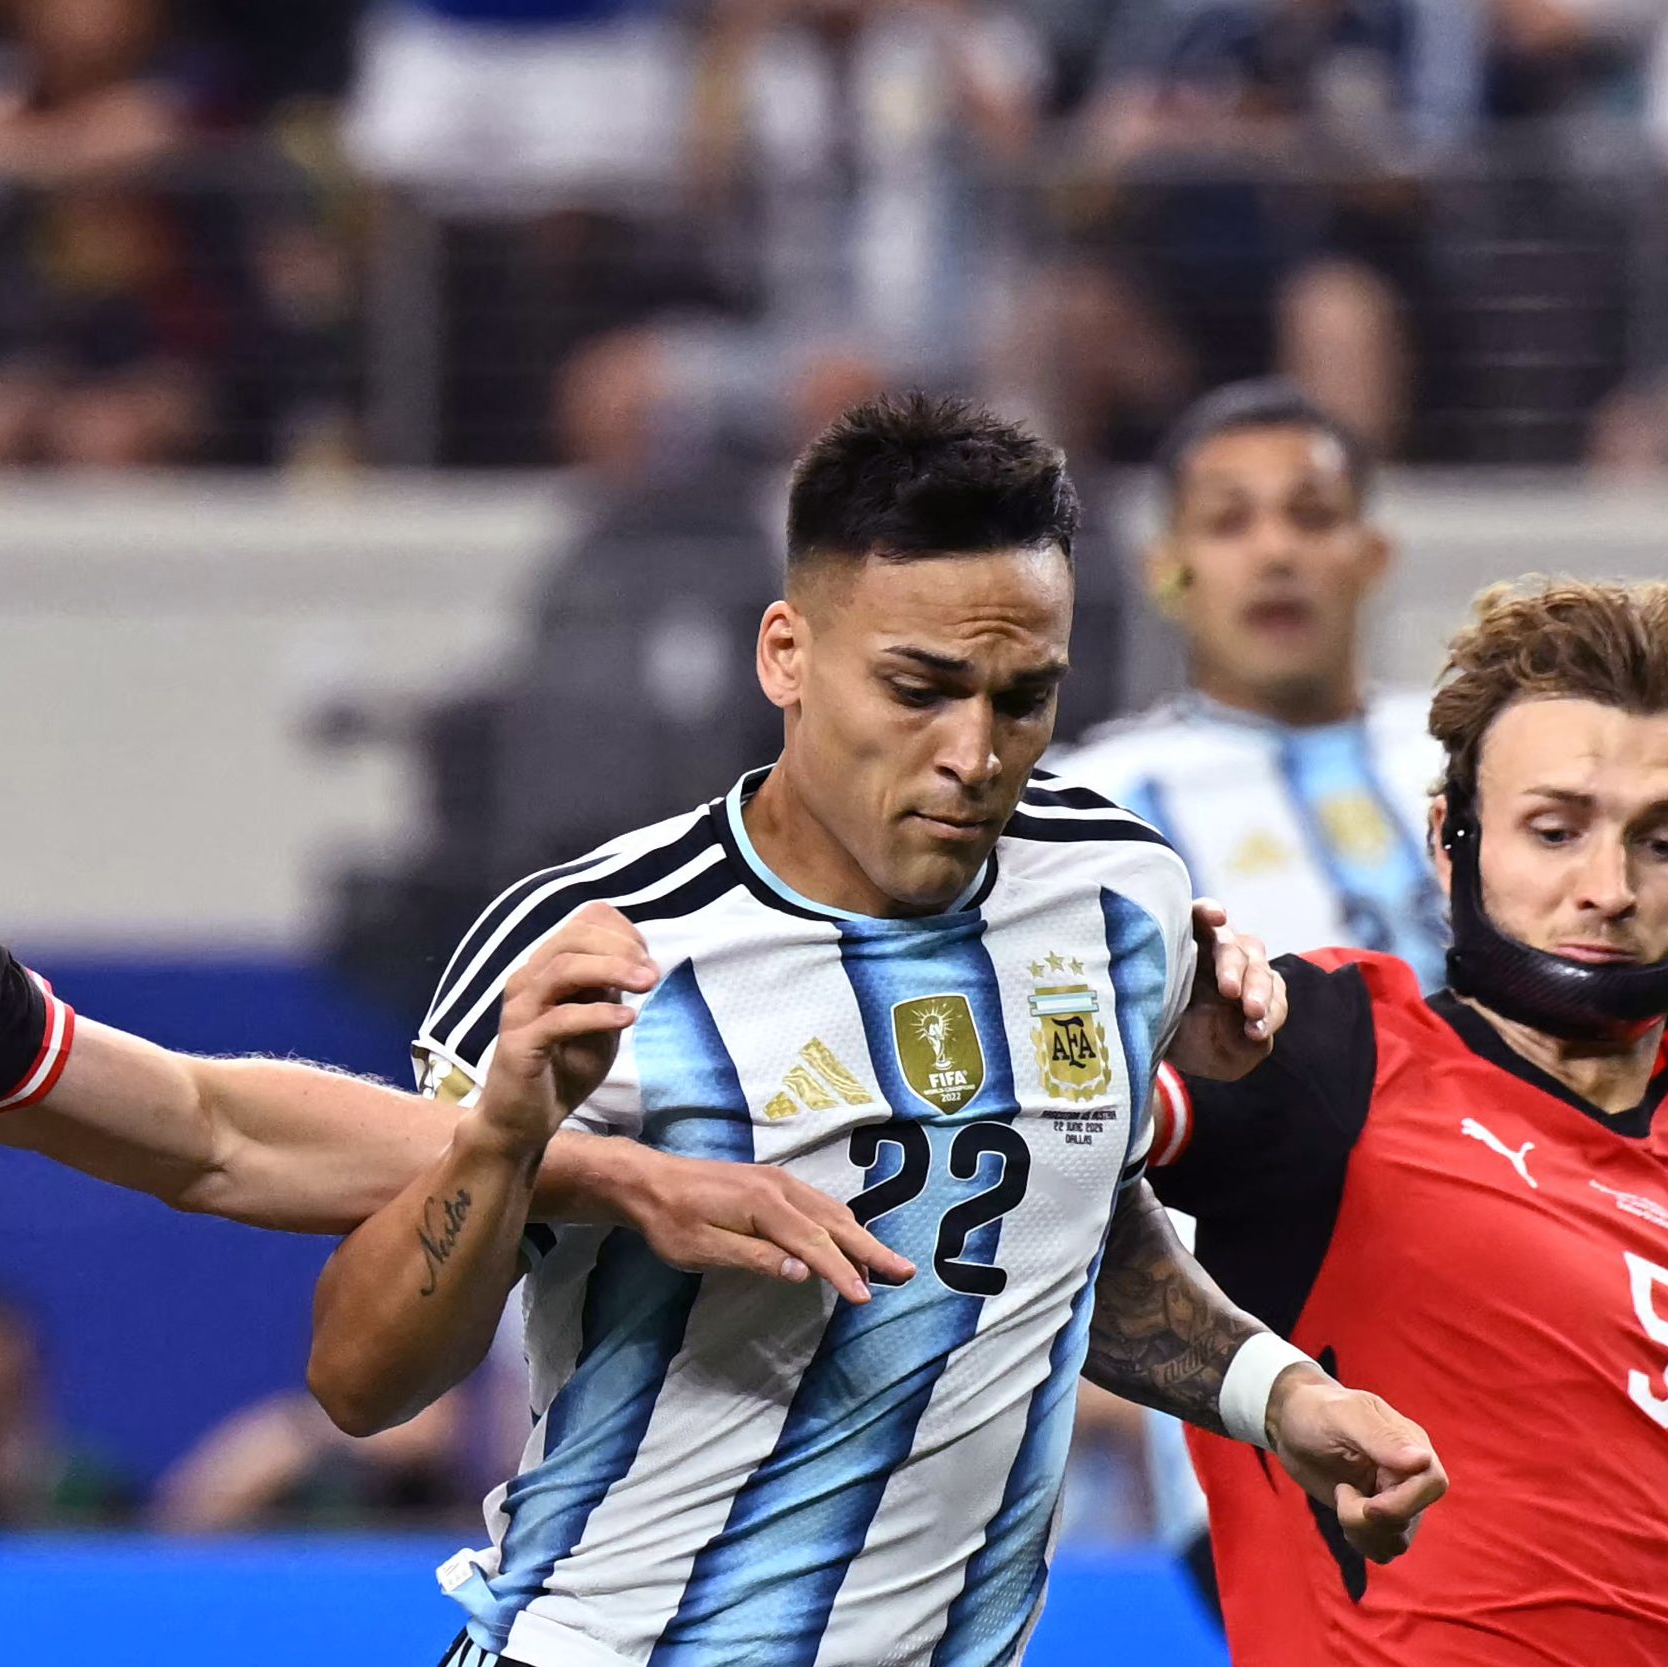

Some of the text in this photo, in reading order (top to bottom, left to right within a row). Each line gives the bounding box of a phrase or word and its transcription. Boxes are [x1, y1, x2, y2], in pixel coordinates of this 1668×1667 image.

[1051, 1016, 1097, 1069] AFA
[928, 1070, 968, 1088] FIFA
[845, 1119, 1031, 1297] 22
